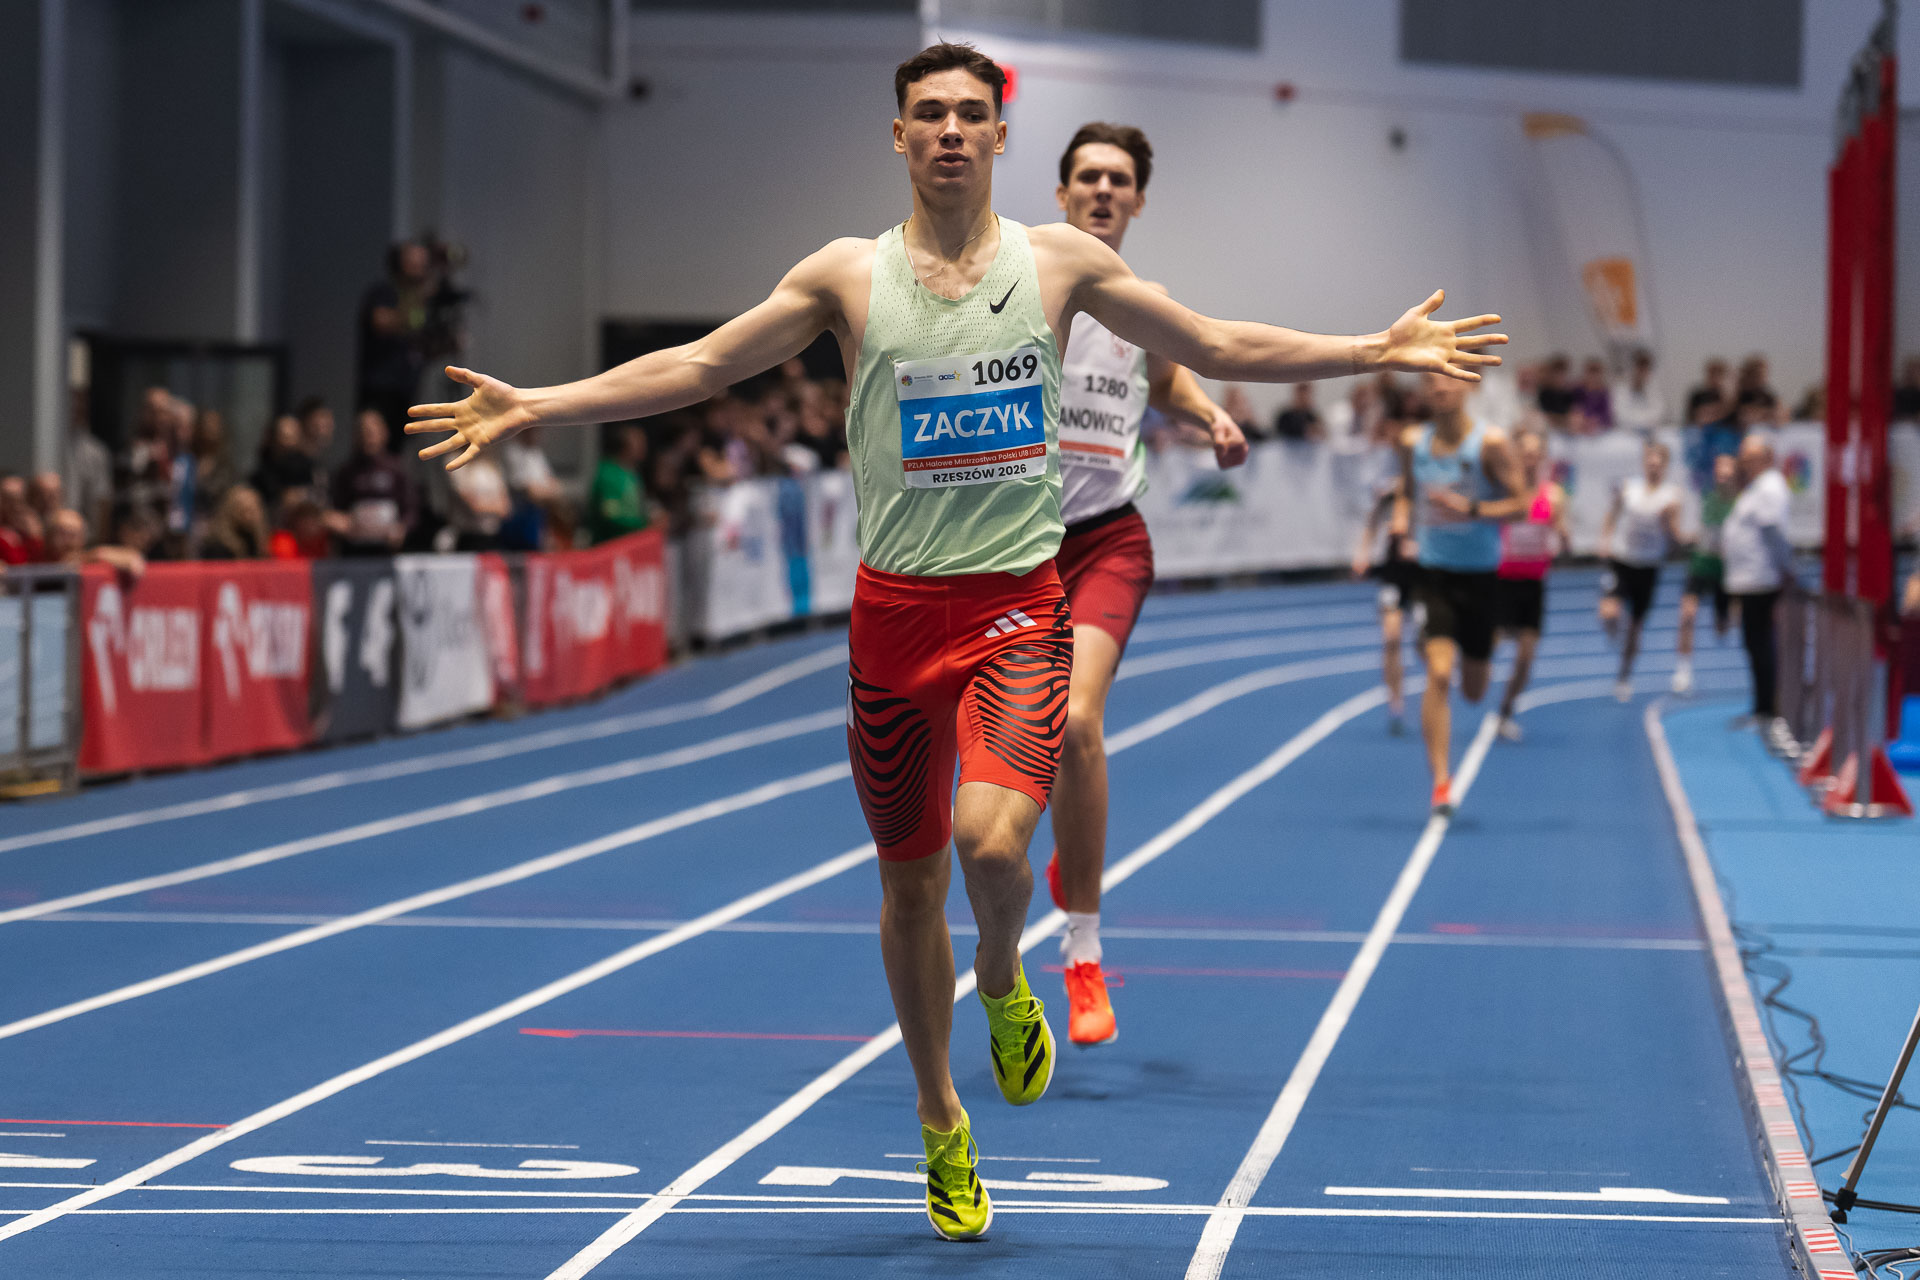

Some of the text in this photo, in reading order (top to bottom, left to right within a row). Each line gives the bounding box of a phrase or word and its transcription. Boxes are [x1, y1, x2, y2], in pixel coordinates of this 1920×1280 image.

[972, 354, 1038, 386] 1069
[1085, 374, 1128, 399] 1280
[913, 402, 1034, 442] ZACZYK
[954, 455, 997, 465] Mistrzostwa
[998, 451, 1018, 460] Polski
[1019, 449, 1029, 457] U18
[933, 463, 1027, 484] RZESZÓW 2026
[230, 1155, 641, 1179] 3
[757, 1166, 1170, 1192] 2
[1324, 1187, 1730, 1205] 1
